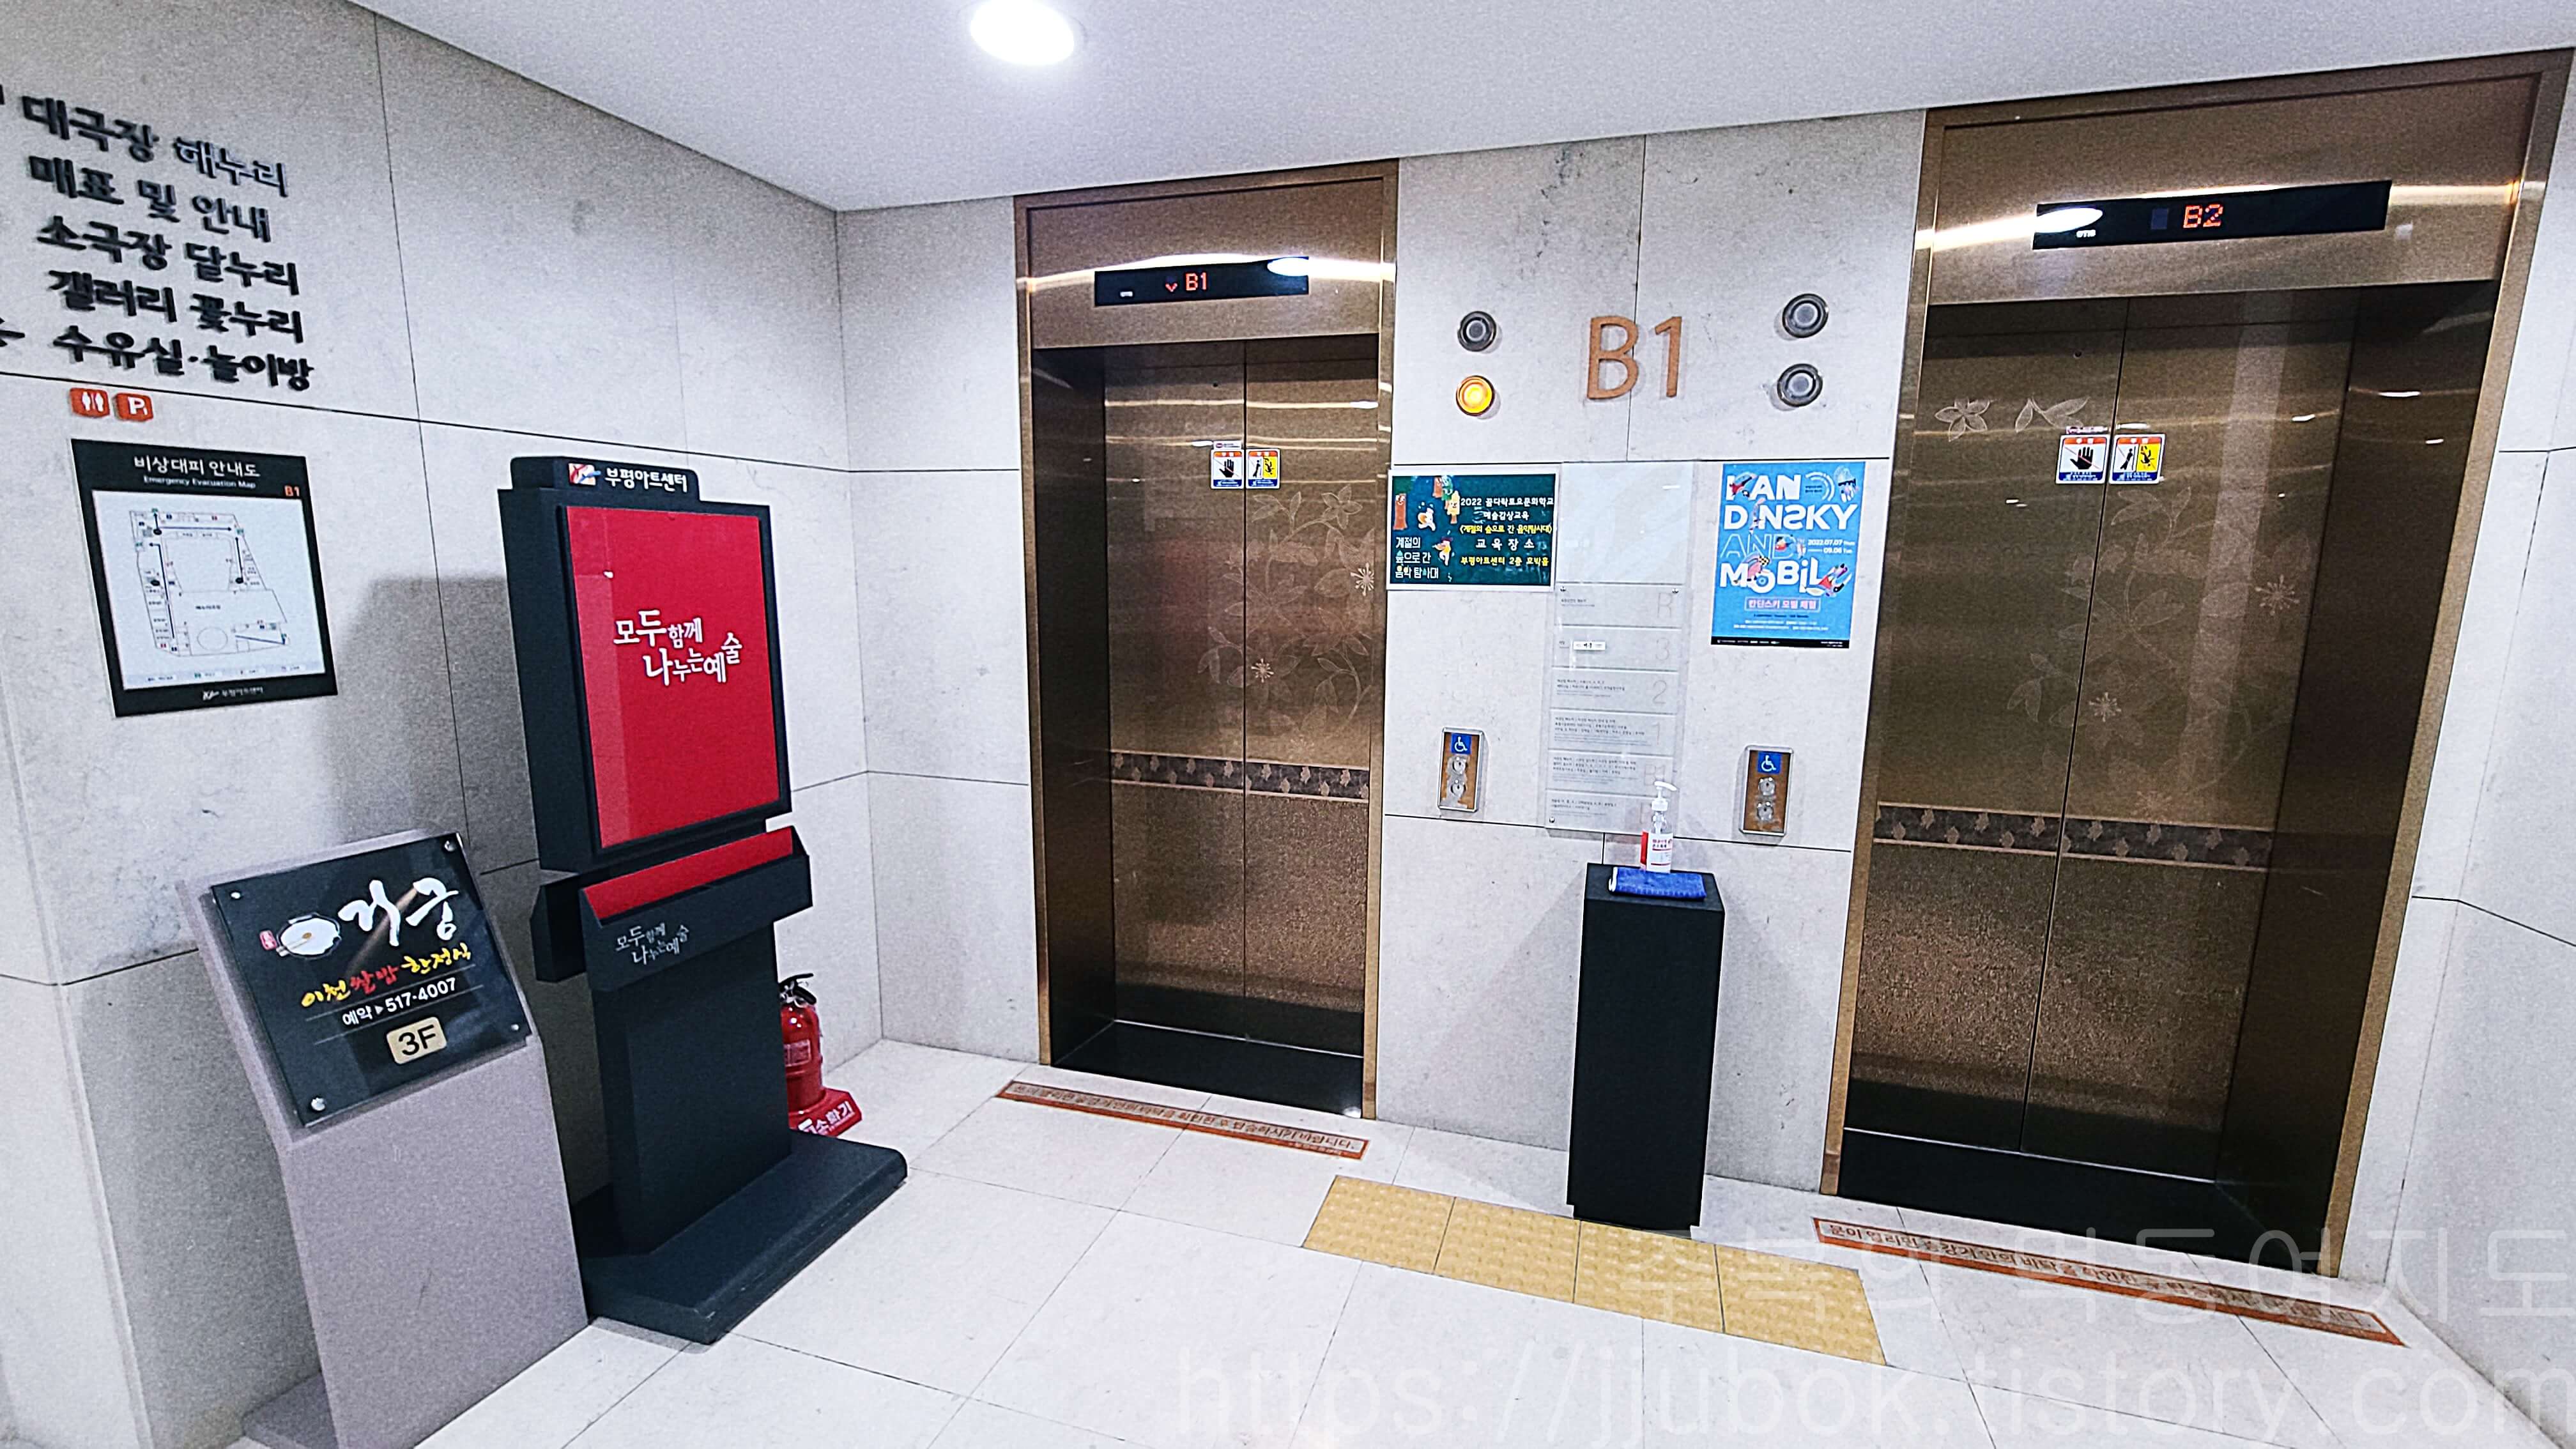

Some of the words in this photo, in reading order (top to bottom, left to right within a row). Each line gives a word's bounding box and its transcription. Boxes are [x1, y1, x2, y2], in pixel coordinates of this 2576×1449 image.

[21, 95, 159, 162] 대극장
[173, 136, 288, 197] 해누리
[29, 155, 124, 204] 매표
[137, 180, 180, 222] 및
[192, 195, 271, 242] 안내
[2182, 203, 2224, 229] B2
[36, 215, 172, 270] 소극장
[184, 242, 299, 295] 달누리
[1185, 272, 1207, 291] B1
[48, 270, 177, 322] 갤러리
[190, 293, 303, 343] 꽃누리
[1586, 315, 1683, 400] B1
[134, 455, 204, 476] 비상대피
[209, 460, 261, 478] 안내도
[143, 475, 190, 486] Emergency
[192, 477, 237, 487] Evacuation
[284, 485, 300, 497] B1
[604, 467, 687, 493] 부평아트센터
[1460, 498, 1482, 506] 2022
[1507, 525, 1515, 535] 간
[1395, 536, 1421, 548] 계절의
[1422, 551, 1431, 564] 간
[1460, 556, 1505, 566] 부평아트센터
[1508, 556, 1522, 567] 2층
[1395, 565, 1412, 579] 음악
[342, 1004, 373, 1026] 예약
[385, 977, 456, 1013] 517-4007
[398, 1025, 437, 1056] 3F
[815, 1101, 855, 1136] 소화기
[1828, 1224, 1862, 1239] 문이
